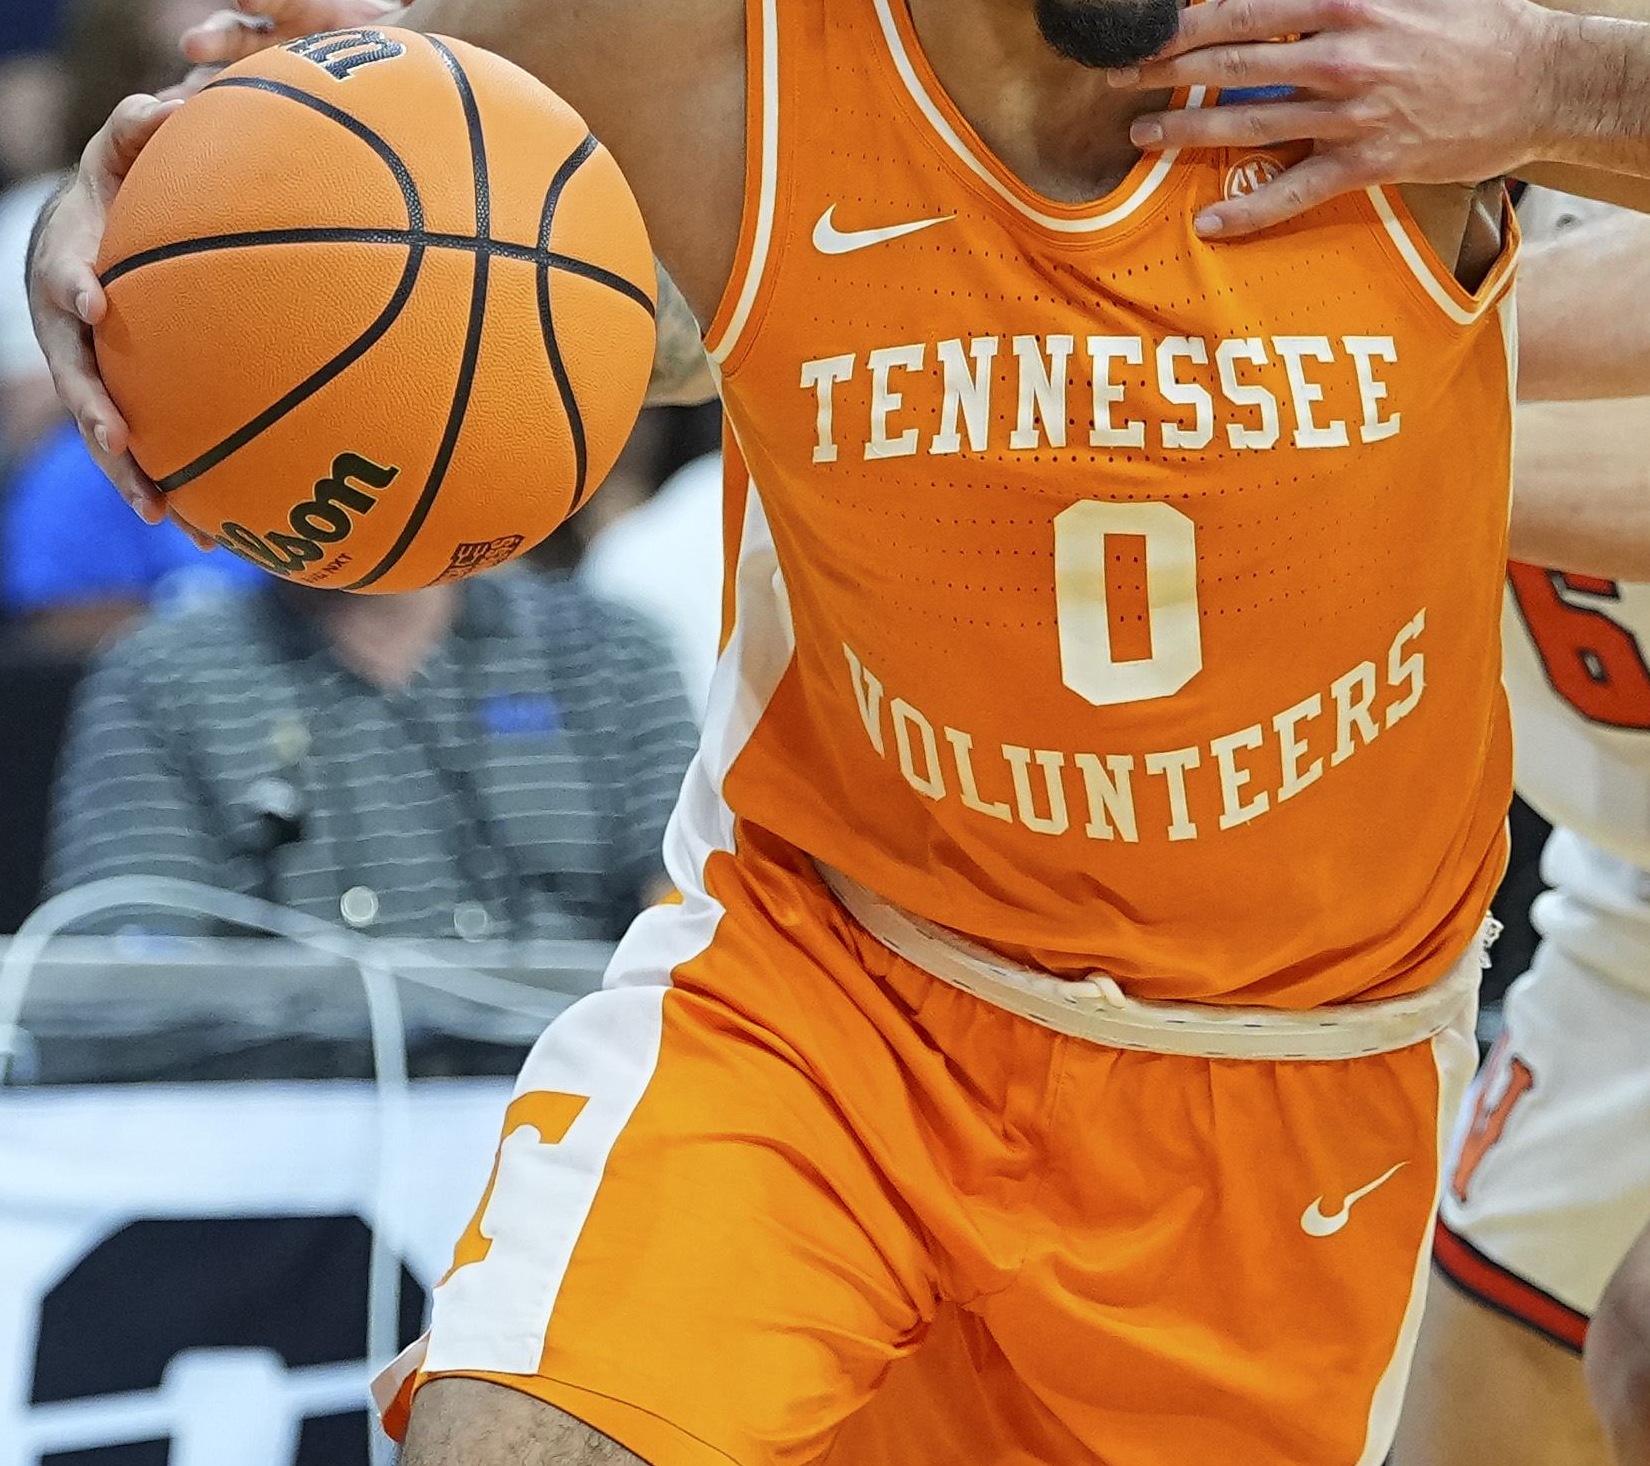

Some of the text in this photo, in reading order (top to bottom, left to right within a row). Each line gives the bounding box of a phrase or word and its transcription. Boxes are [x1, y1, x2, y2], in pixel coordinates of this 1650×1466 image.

[800, 335, 1401, 464] TENNESSEE
[1052, 499, 1204, 707] 0
[842, 607, 1428, 843] VOLUNTEERS
